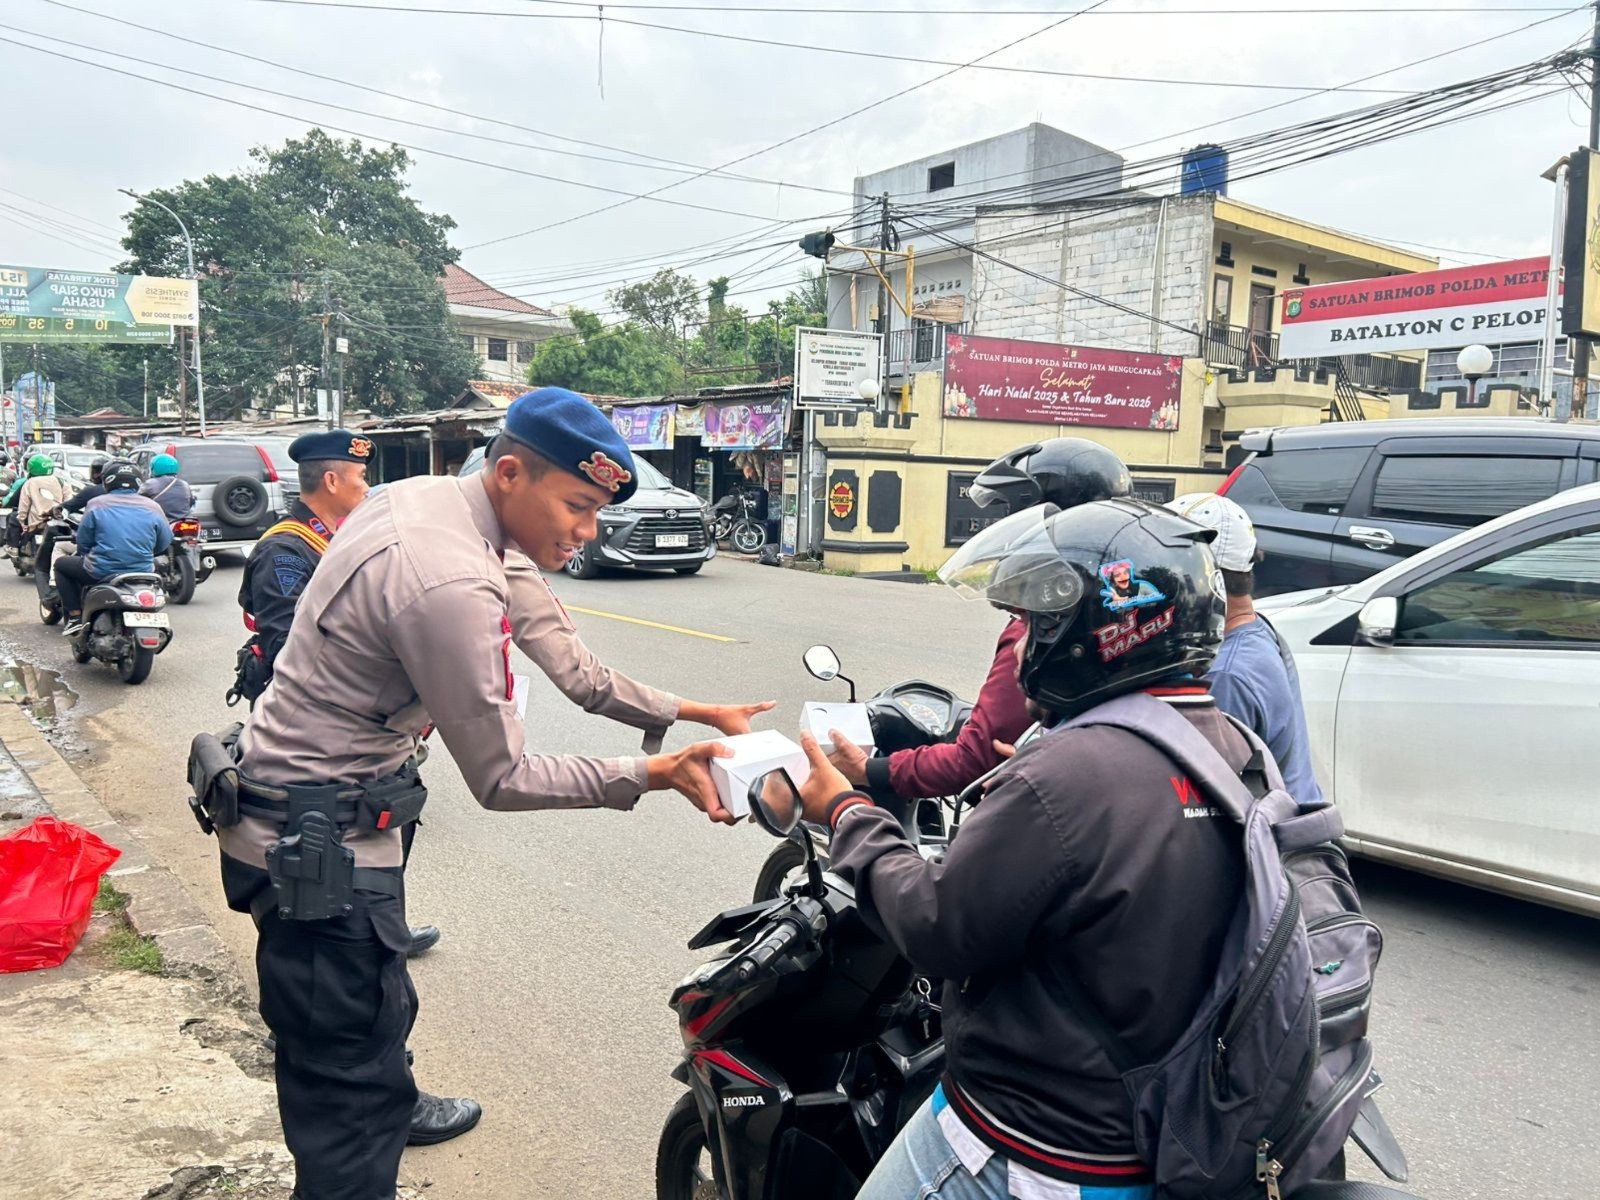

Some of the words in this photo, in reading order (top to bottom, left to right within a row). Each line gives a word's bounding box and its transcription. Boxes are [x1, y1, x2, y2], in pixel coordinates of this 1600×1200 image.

[1308, 291, 1370, 309] SATUAN
[1373, 284, 1436, 302] BRIMOB
[1440, 276, 1498, 294] POLDA
[1330, 318, 1443, 342] BATALYON
[1450, 316, 1465, 331] C
[969, 352, 1000, 362] SATUAN
[1002, 355, 1033, 365] BRIMOB
[1034, 358, 1060, 367] POLDA
[1061, 360, 1089, 369] METRO
[1089, 363, 1106, 371] JAYA
[1107, 365, 1162, 376] MENGUCAPKAN
[1040, 367, 1092, 390] Selamat
[978, 384, 1002, 397] Hari
[1004, 385, 1035, 399] Natal
[1034, 391, 1058, 404] 2025
[1060, 391, 1070, 404] &
[1073, 389, 1102, 404] Tahun
[1104, 393, 1126, 406] Baru
[1128, 396, 1151, 408] 2026
[1096, 609, 1138, 644] DJ
[723, 1096, 765, 1107] HONDA
